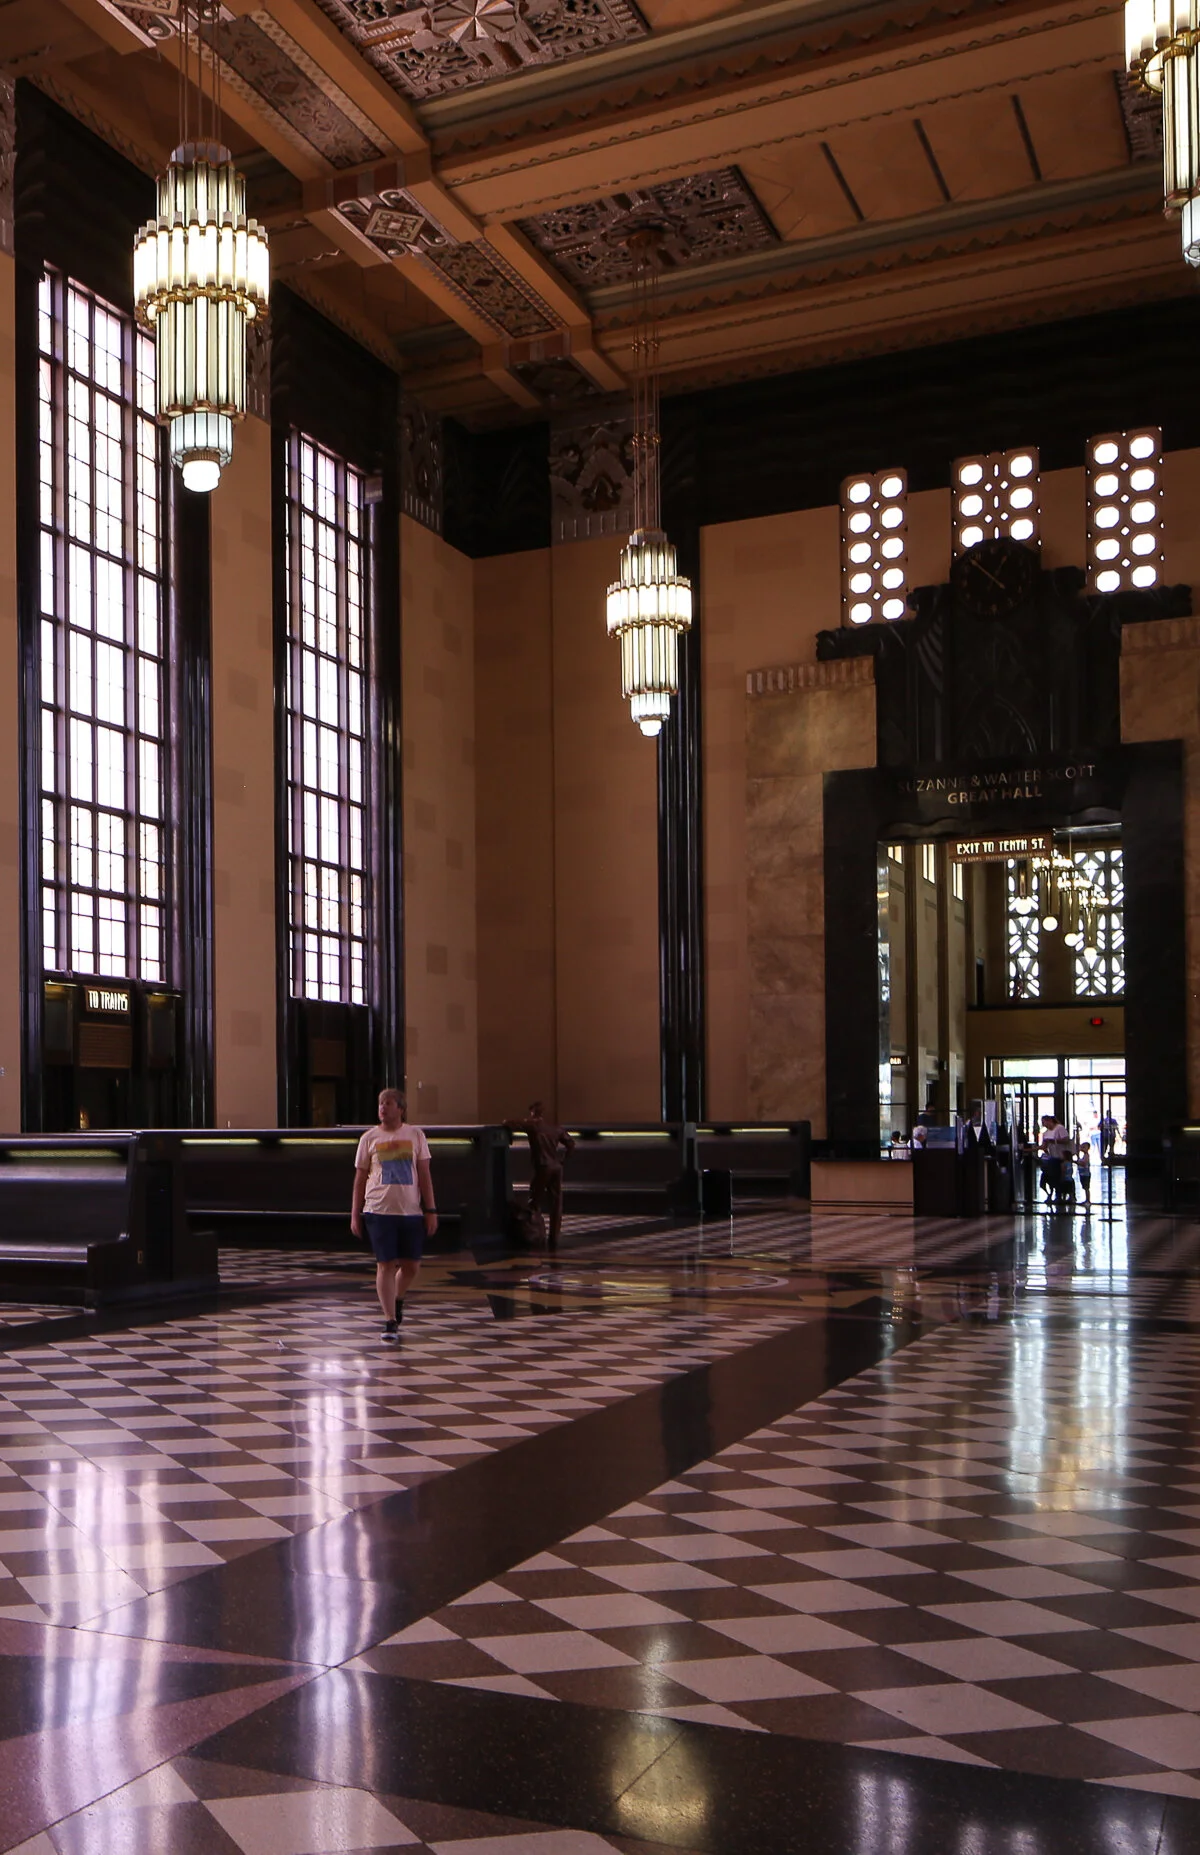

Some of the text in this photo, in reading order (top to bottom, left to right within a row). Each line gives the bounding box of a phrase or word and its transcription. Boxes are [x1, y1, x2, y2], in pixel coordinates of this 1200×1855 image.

[970, 774, 981, 787] &
[1046, 764, 1096, 781] SCOTT
[947, 785, 1043, 805] GREAT HALL
[956, 837, 1046, 855] EXIT TO TENTH ST.
[87, 989, 128, 1011] TO TRAINS
